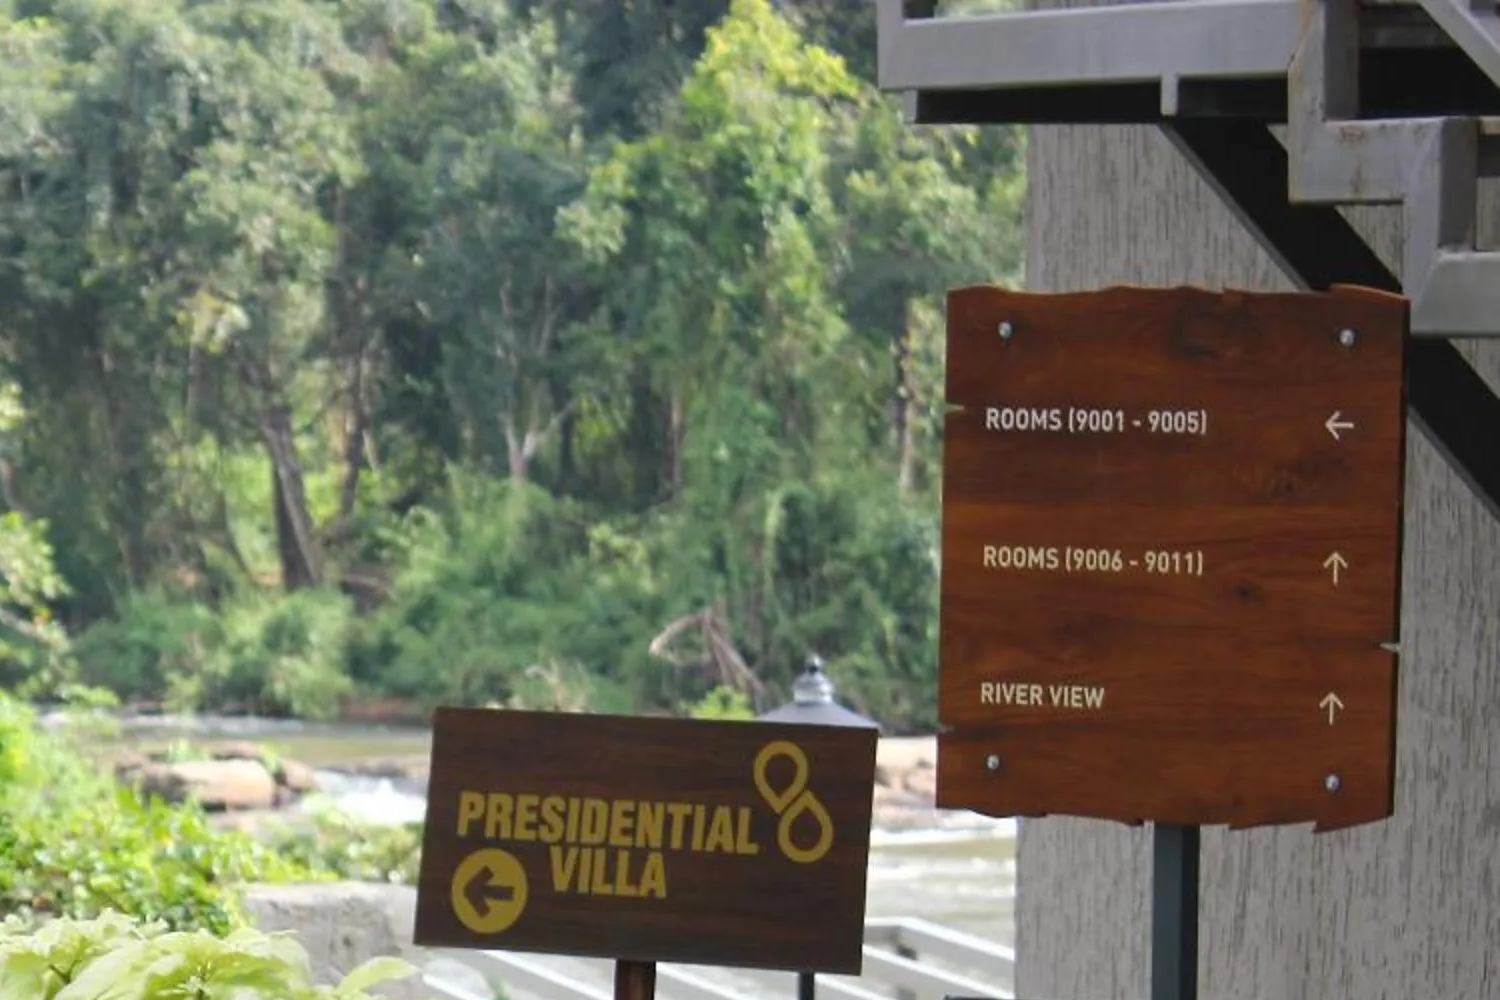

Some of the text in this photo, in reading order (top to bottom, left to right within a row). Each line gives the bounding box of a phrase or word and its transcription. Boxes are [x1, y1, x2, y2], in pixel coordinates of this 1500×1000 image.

[985, 407, 1062, 431] ROOMS
[1067, 408, 1125, 433] (9001
[1148, 410, 1207, 435] 9005)
[982, 545, 1060, 569] ROOMS
[1064, 546, 1123, 573] (9006
[1144, 549, 1203, 575] 9011)
[980, 682, 1105, 709] RIVER VIEW
[456, 791, 759, 855] PRESIDENTIAL
[550, 845, 667, 898] VILLA
